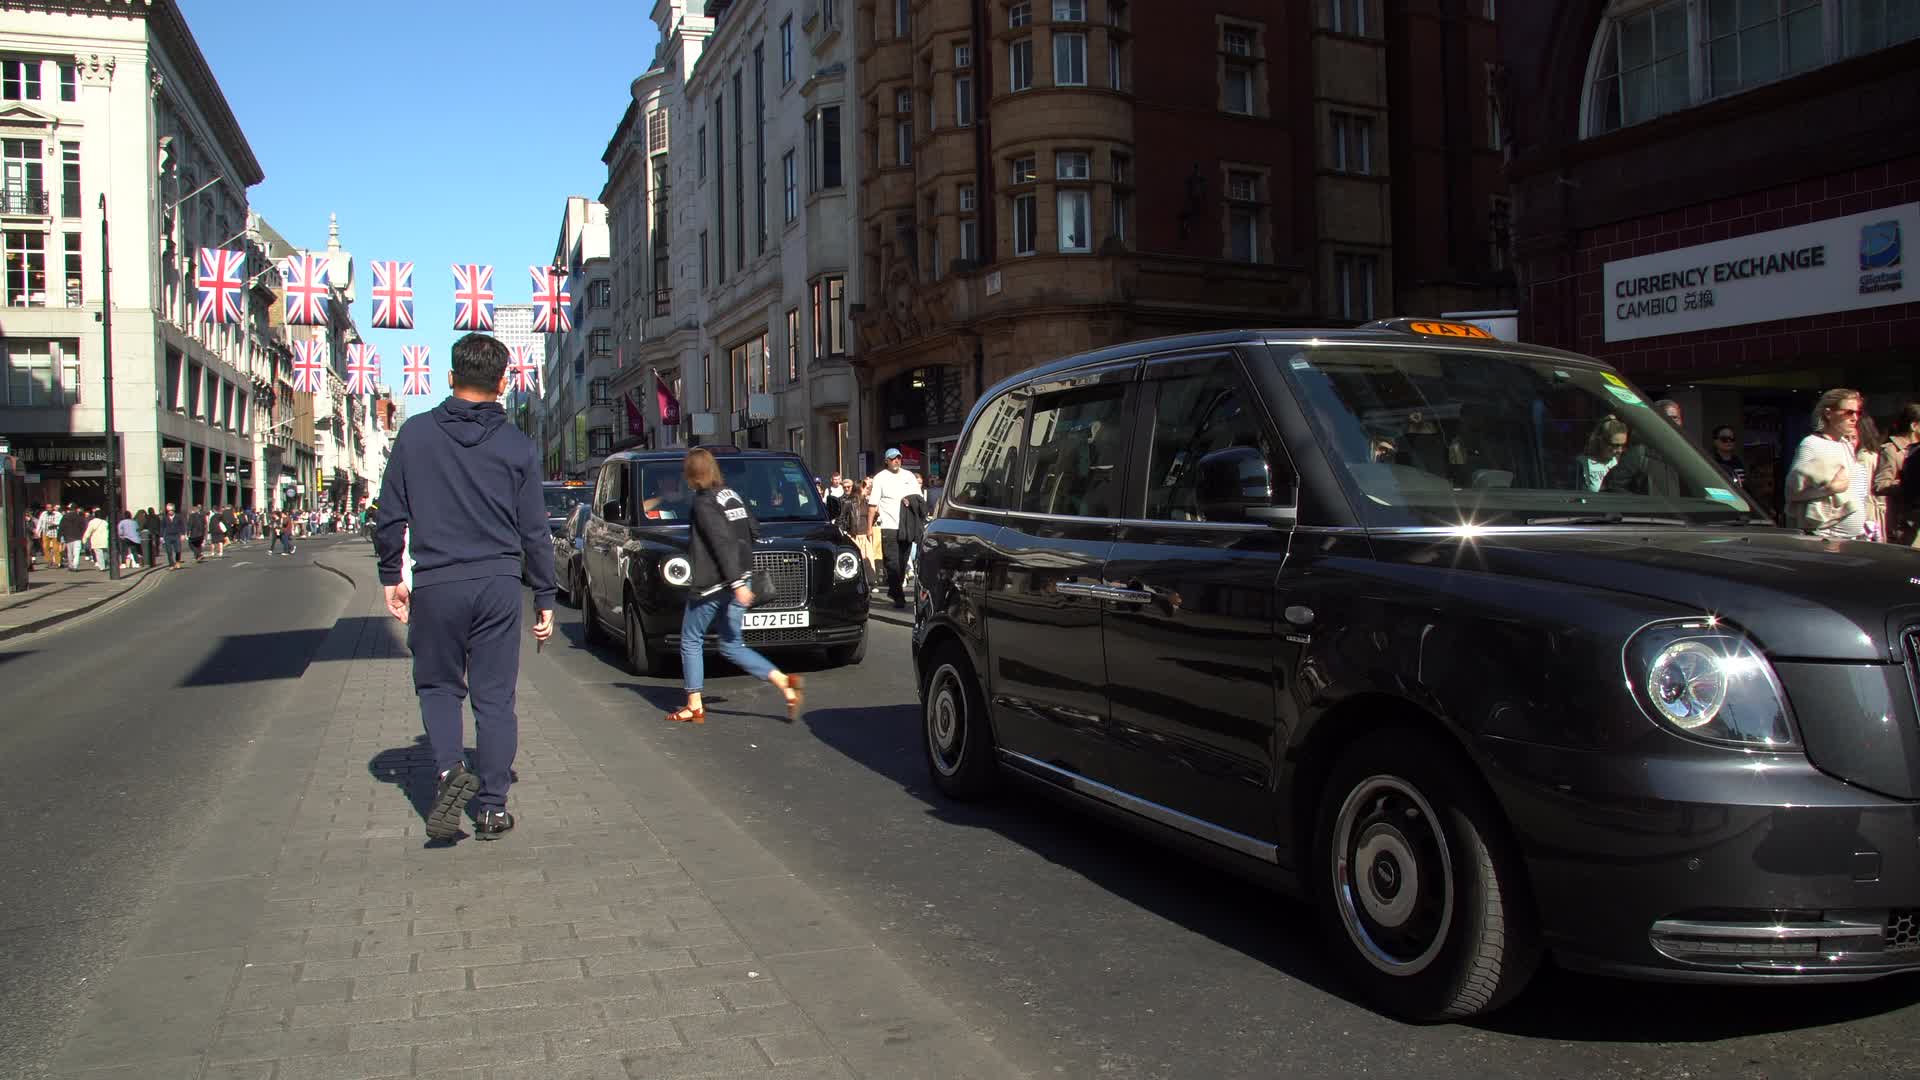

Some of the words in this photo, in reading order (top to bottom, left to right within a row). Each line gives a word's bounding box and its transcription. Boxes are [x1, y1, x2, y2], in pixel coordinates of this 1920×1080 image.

[1615, 266, 1708, 298] CURRENCY
[1714, 245, 1825, 282] EXCHANGE
[1859, 270, 1903, 285] Global
[1616, 295, 1677, 320] CAMBIO
[1417, 324, 1489, 337] TAXI
[743, 615, 777, 627] LC72
[780, 613, 804, 625] FDE
